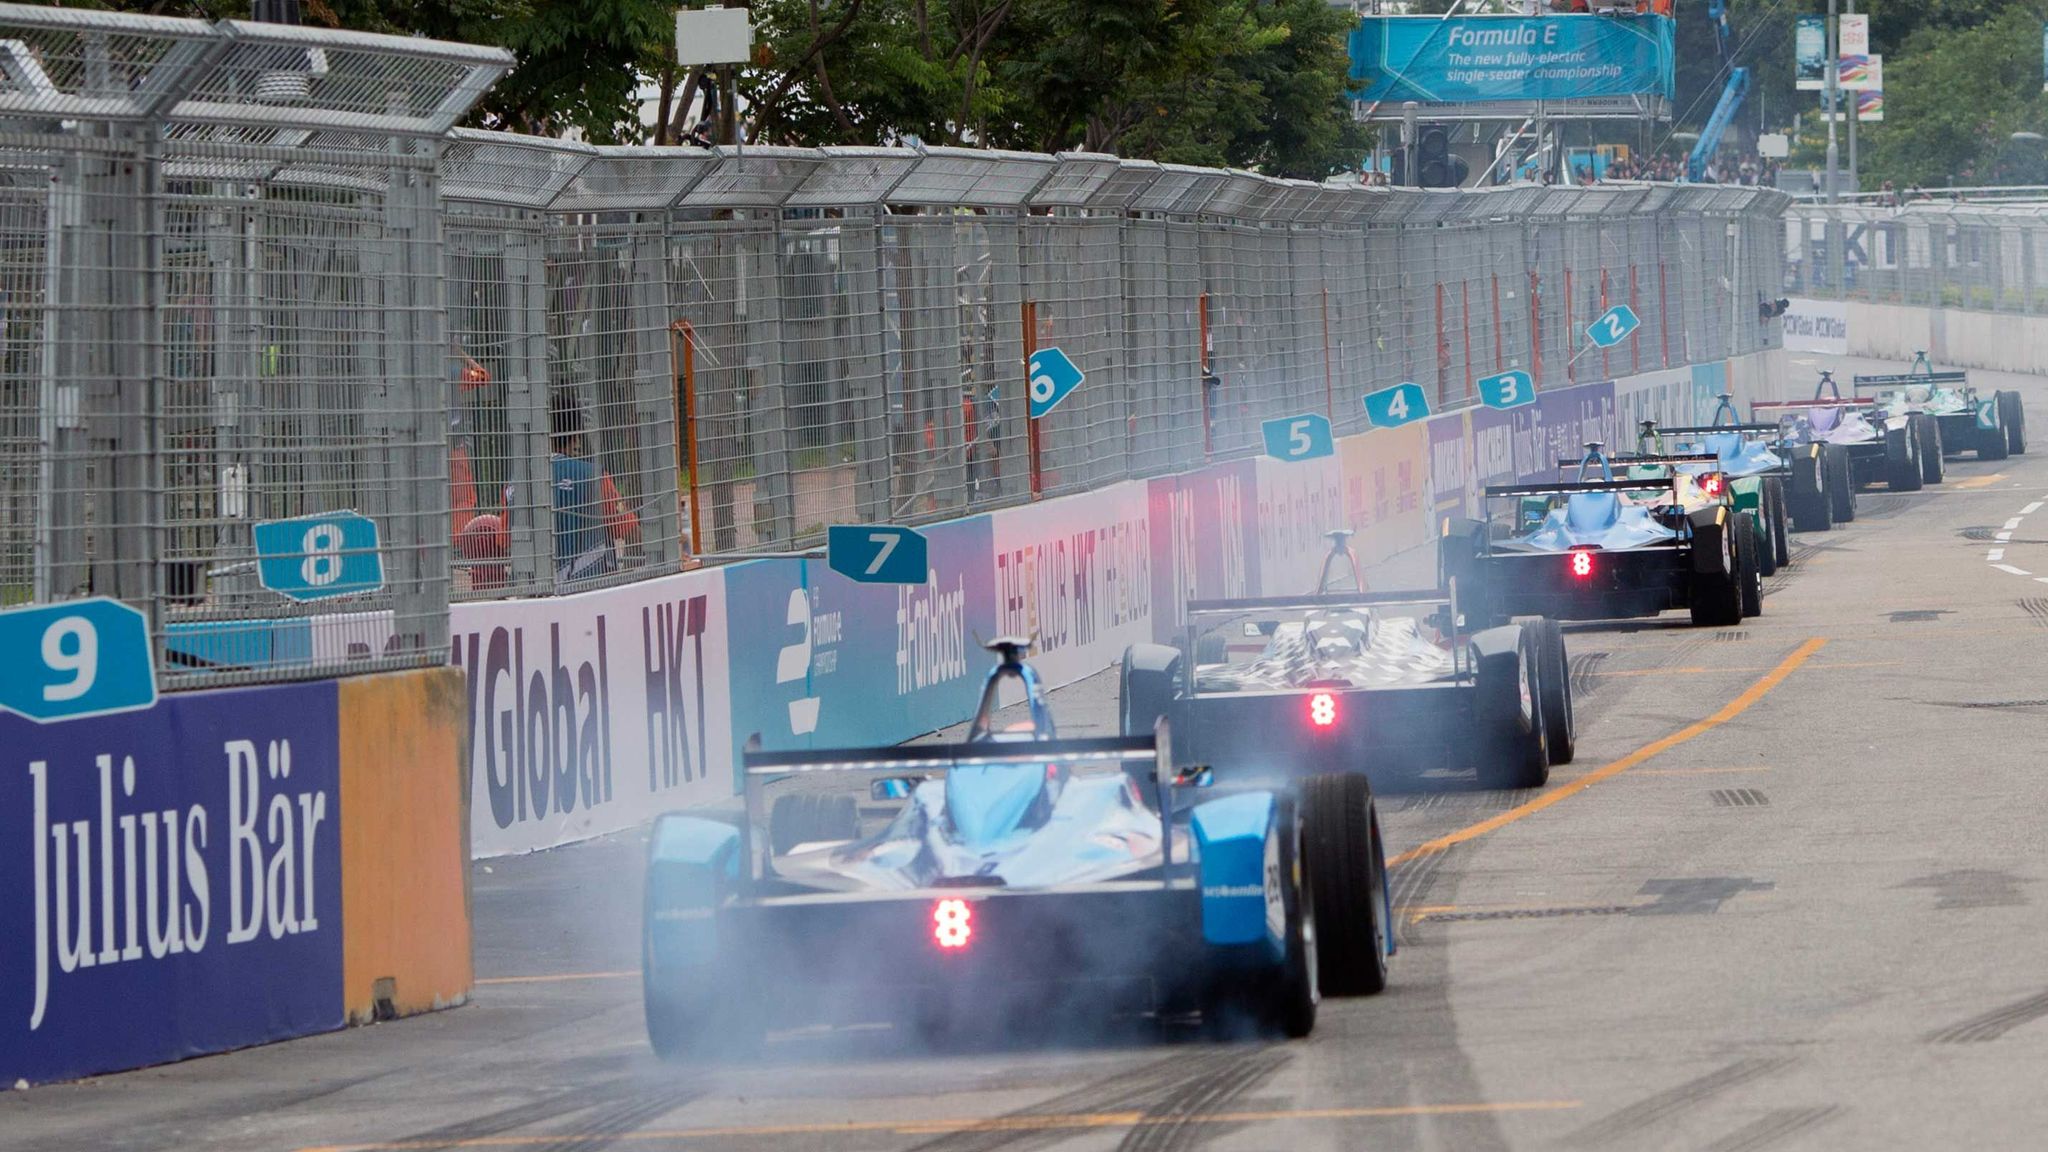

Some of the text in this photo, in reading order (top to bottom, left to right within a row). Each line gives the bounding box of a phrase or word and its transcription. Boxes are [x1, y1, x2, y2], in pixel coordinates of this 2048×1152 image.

[1449, 24, 1559, 46] Formula E
[1446, 64, 1622, 83] single-seater championship
[1449, 50, 1586, 67] The new fully-electric
[1603, 313, 1624, 339] 2
[1030, 361, 1055, 404] 6
[1500, 377, 1517, 403] 3
[1387, 390, 1410, 419] 4
[1288, 420, 1312, 455] 5
[301, 523, 344, 586] 8
[864, 533, 900, 575] 7
[1573, 552, 1591, 575] 8
[1072, 530, 1096, 647] HKT
[897, 568, 966, 695] #FanBoost
[40, 616, 99, 701] 9
[484, 615, 612, 829] Global
[642, 594, 707, 792] HKT
[1311, 694, 1335, 725] 8
[29, 739, 326, 1031] Julius Bär
[934, 899, 971, 947] 8
